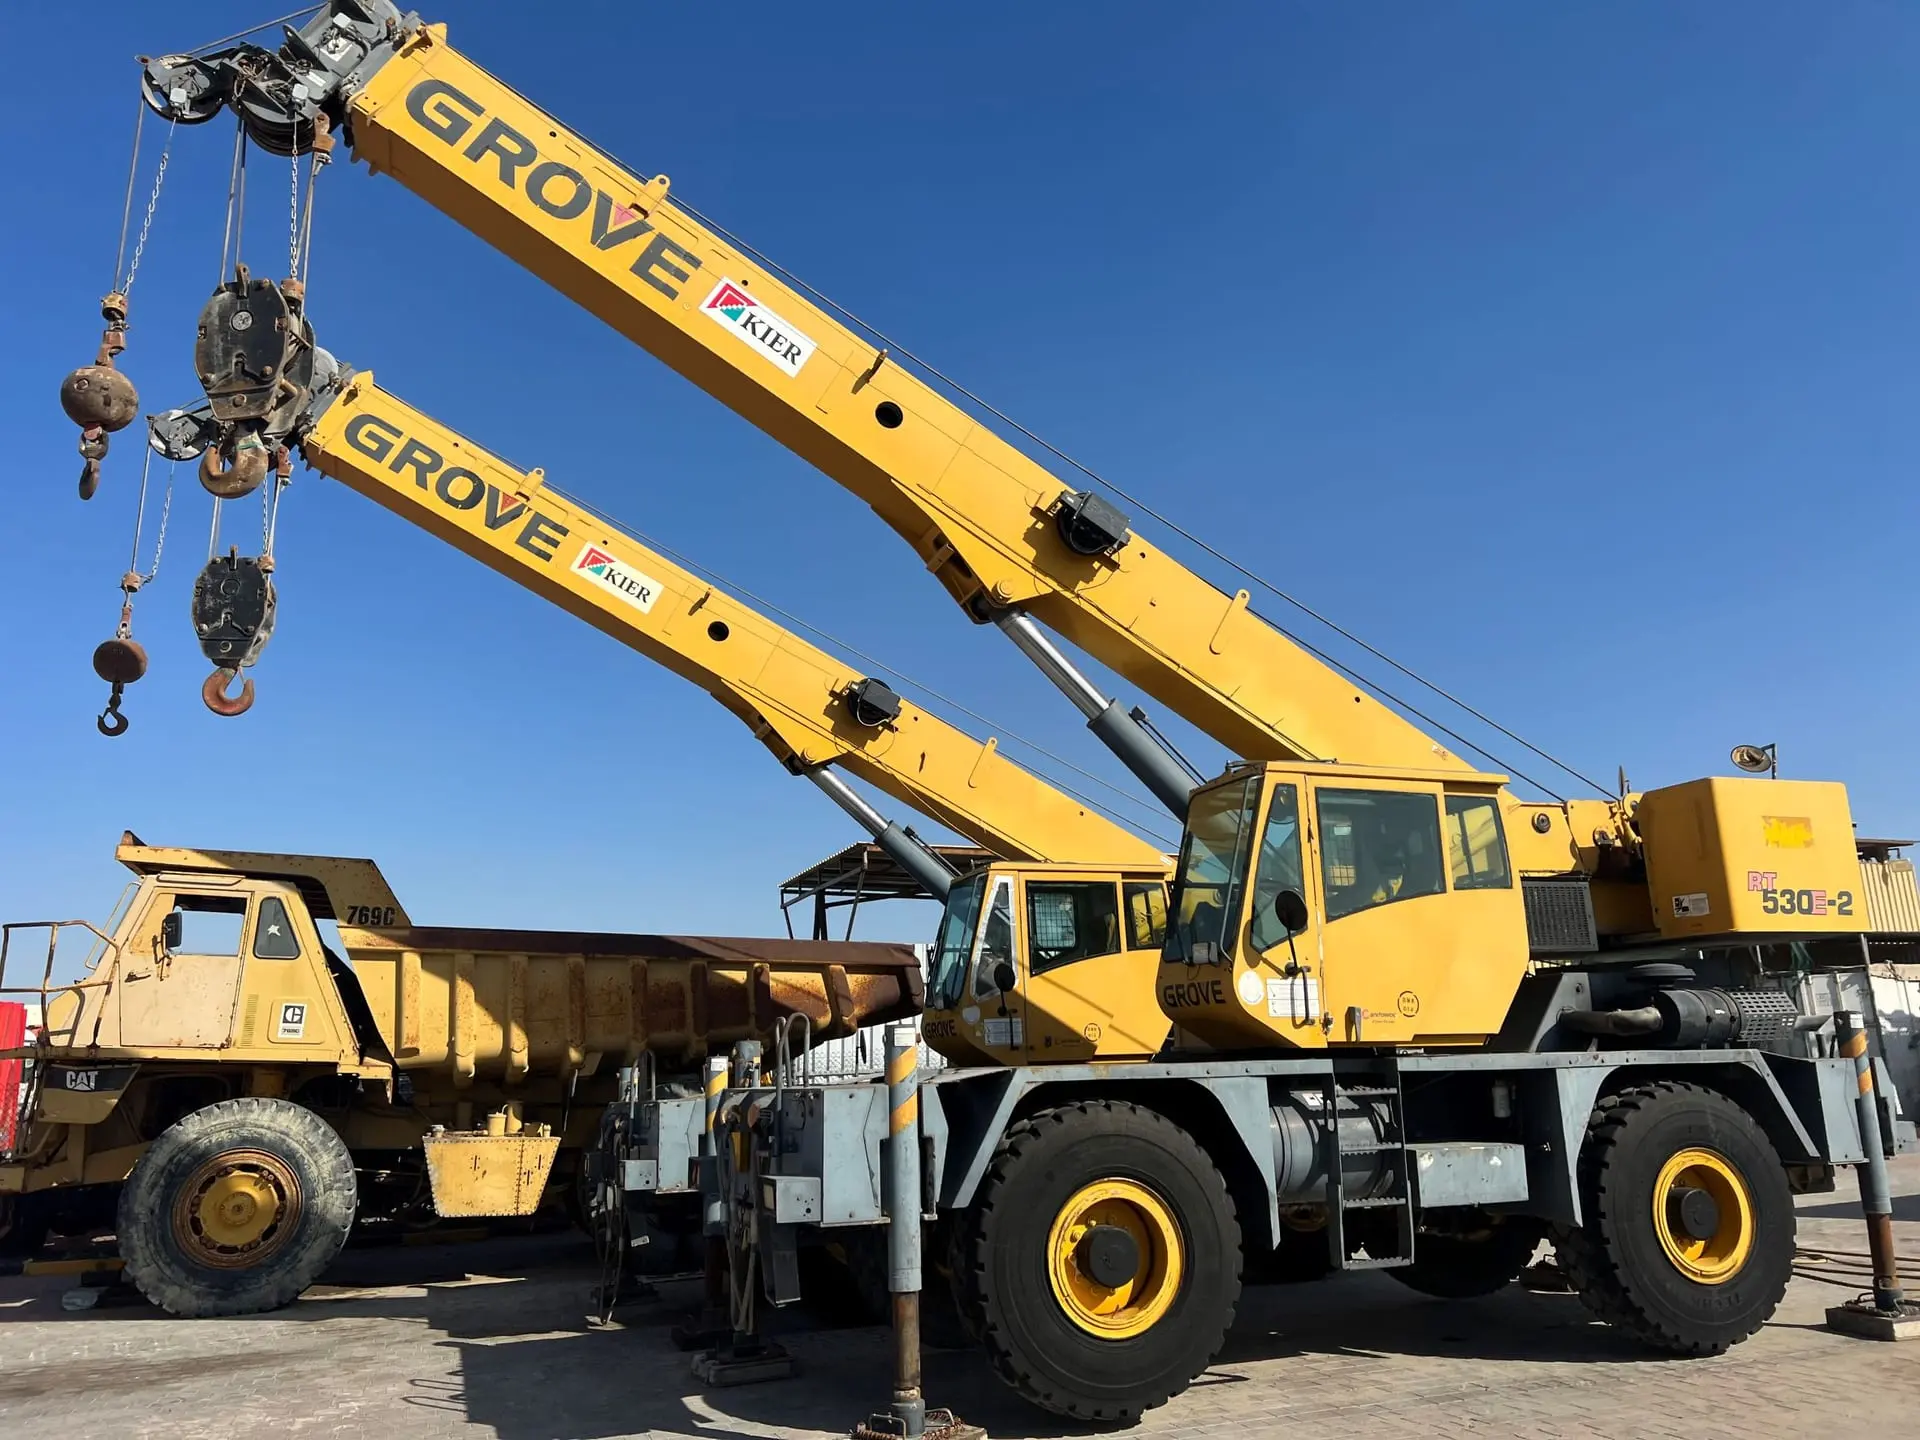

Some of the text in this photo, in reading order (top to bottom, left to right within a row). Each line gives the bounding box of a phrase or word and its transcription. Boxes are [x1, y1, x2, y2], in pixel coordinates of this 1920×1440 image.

[405, 79, 703, 301] GROVE
[740, 311, 802, 366] KIER
[344, 413, 570, 562] GROVE
[603, 567, 652, 604] KIER
[1747, 871, 1777, 891] RT
[346, 905, 396, 926] 769C
[1762, 889, 1853, 916] 530E-2
[1163, 979, 1227, 1008] GROVE
[924, 1019, 957, 1040] GROVE
[66, 1070, 99, 1090] CAT
